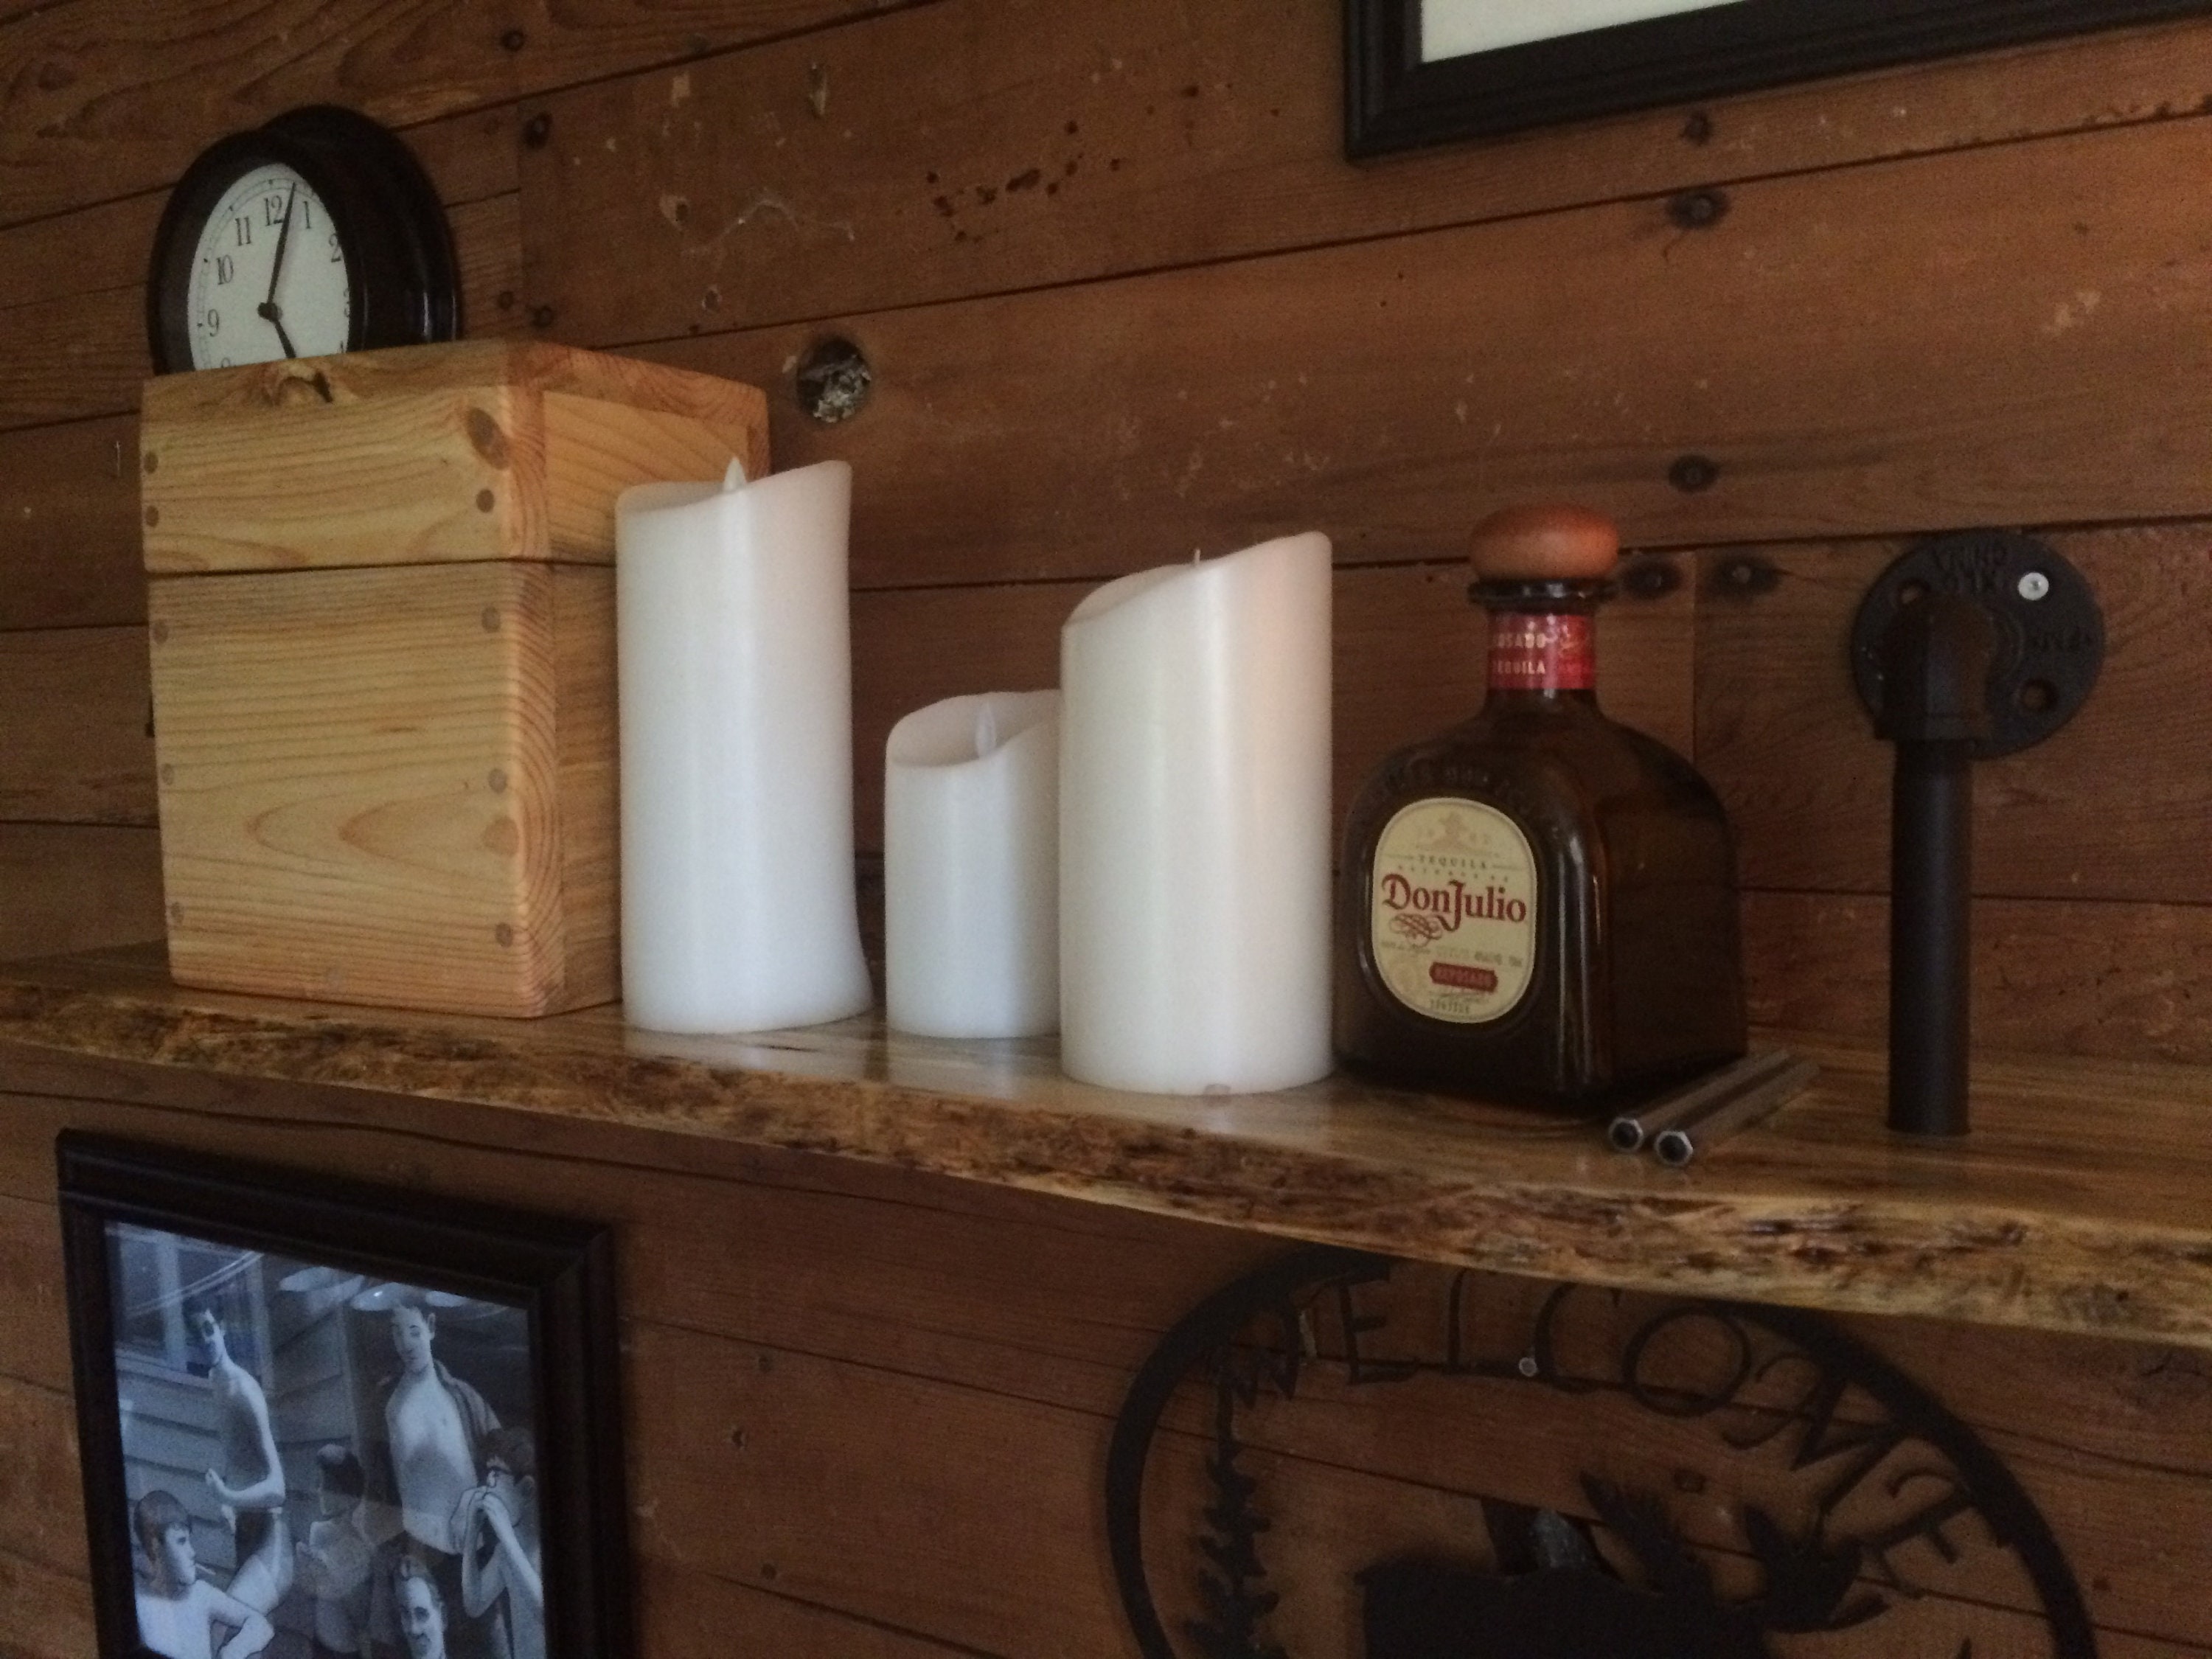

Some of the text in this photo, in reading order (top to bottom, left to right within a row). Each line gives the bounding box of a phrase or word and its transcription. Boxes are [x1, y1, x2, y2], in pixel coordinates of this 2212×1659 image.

[263, 195, 283, 227] 12
[302, 200, 312, 230] 1
[234, 216, 252, 247] 11
[329, 233, 342, 263] 2
[216, 254, 234, 286] 10
[207, 308, 220, 338] 9
